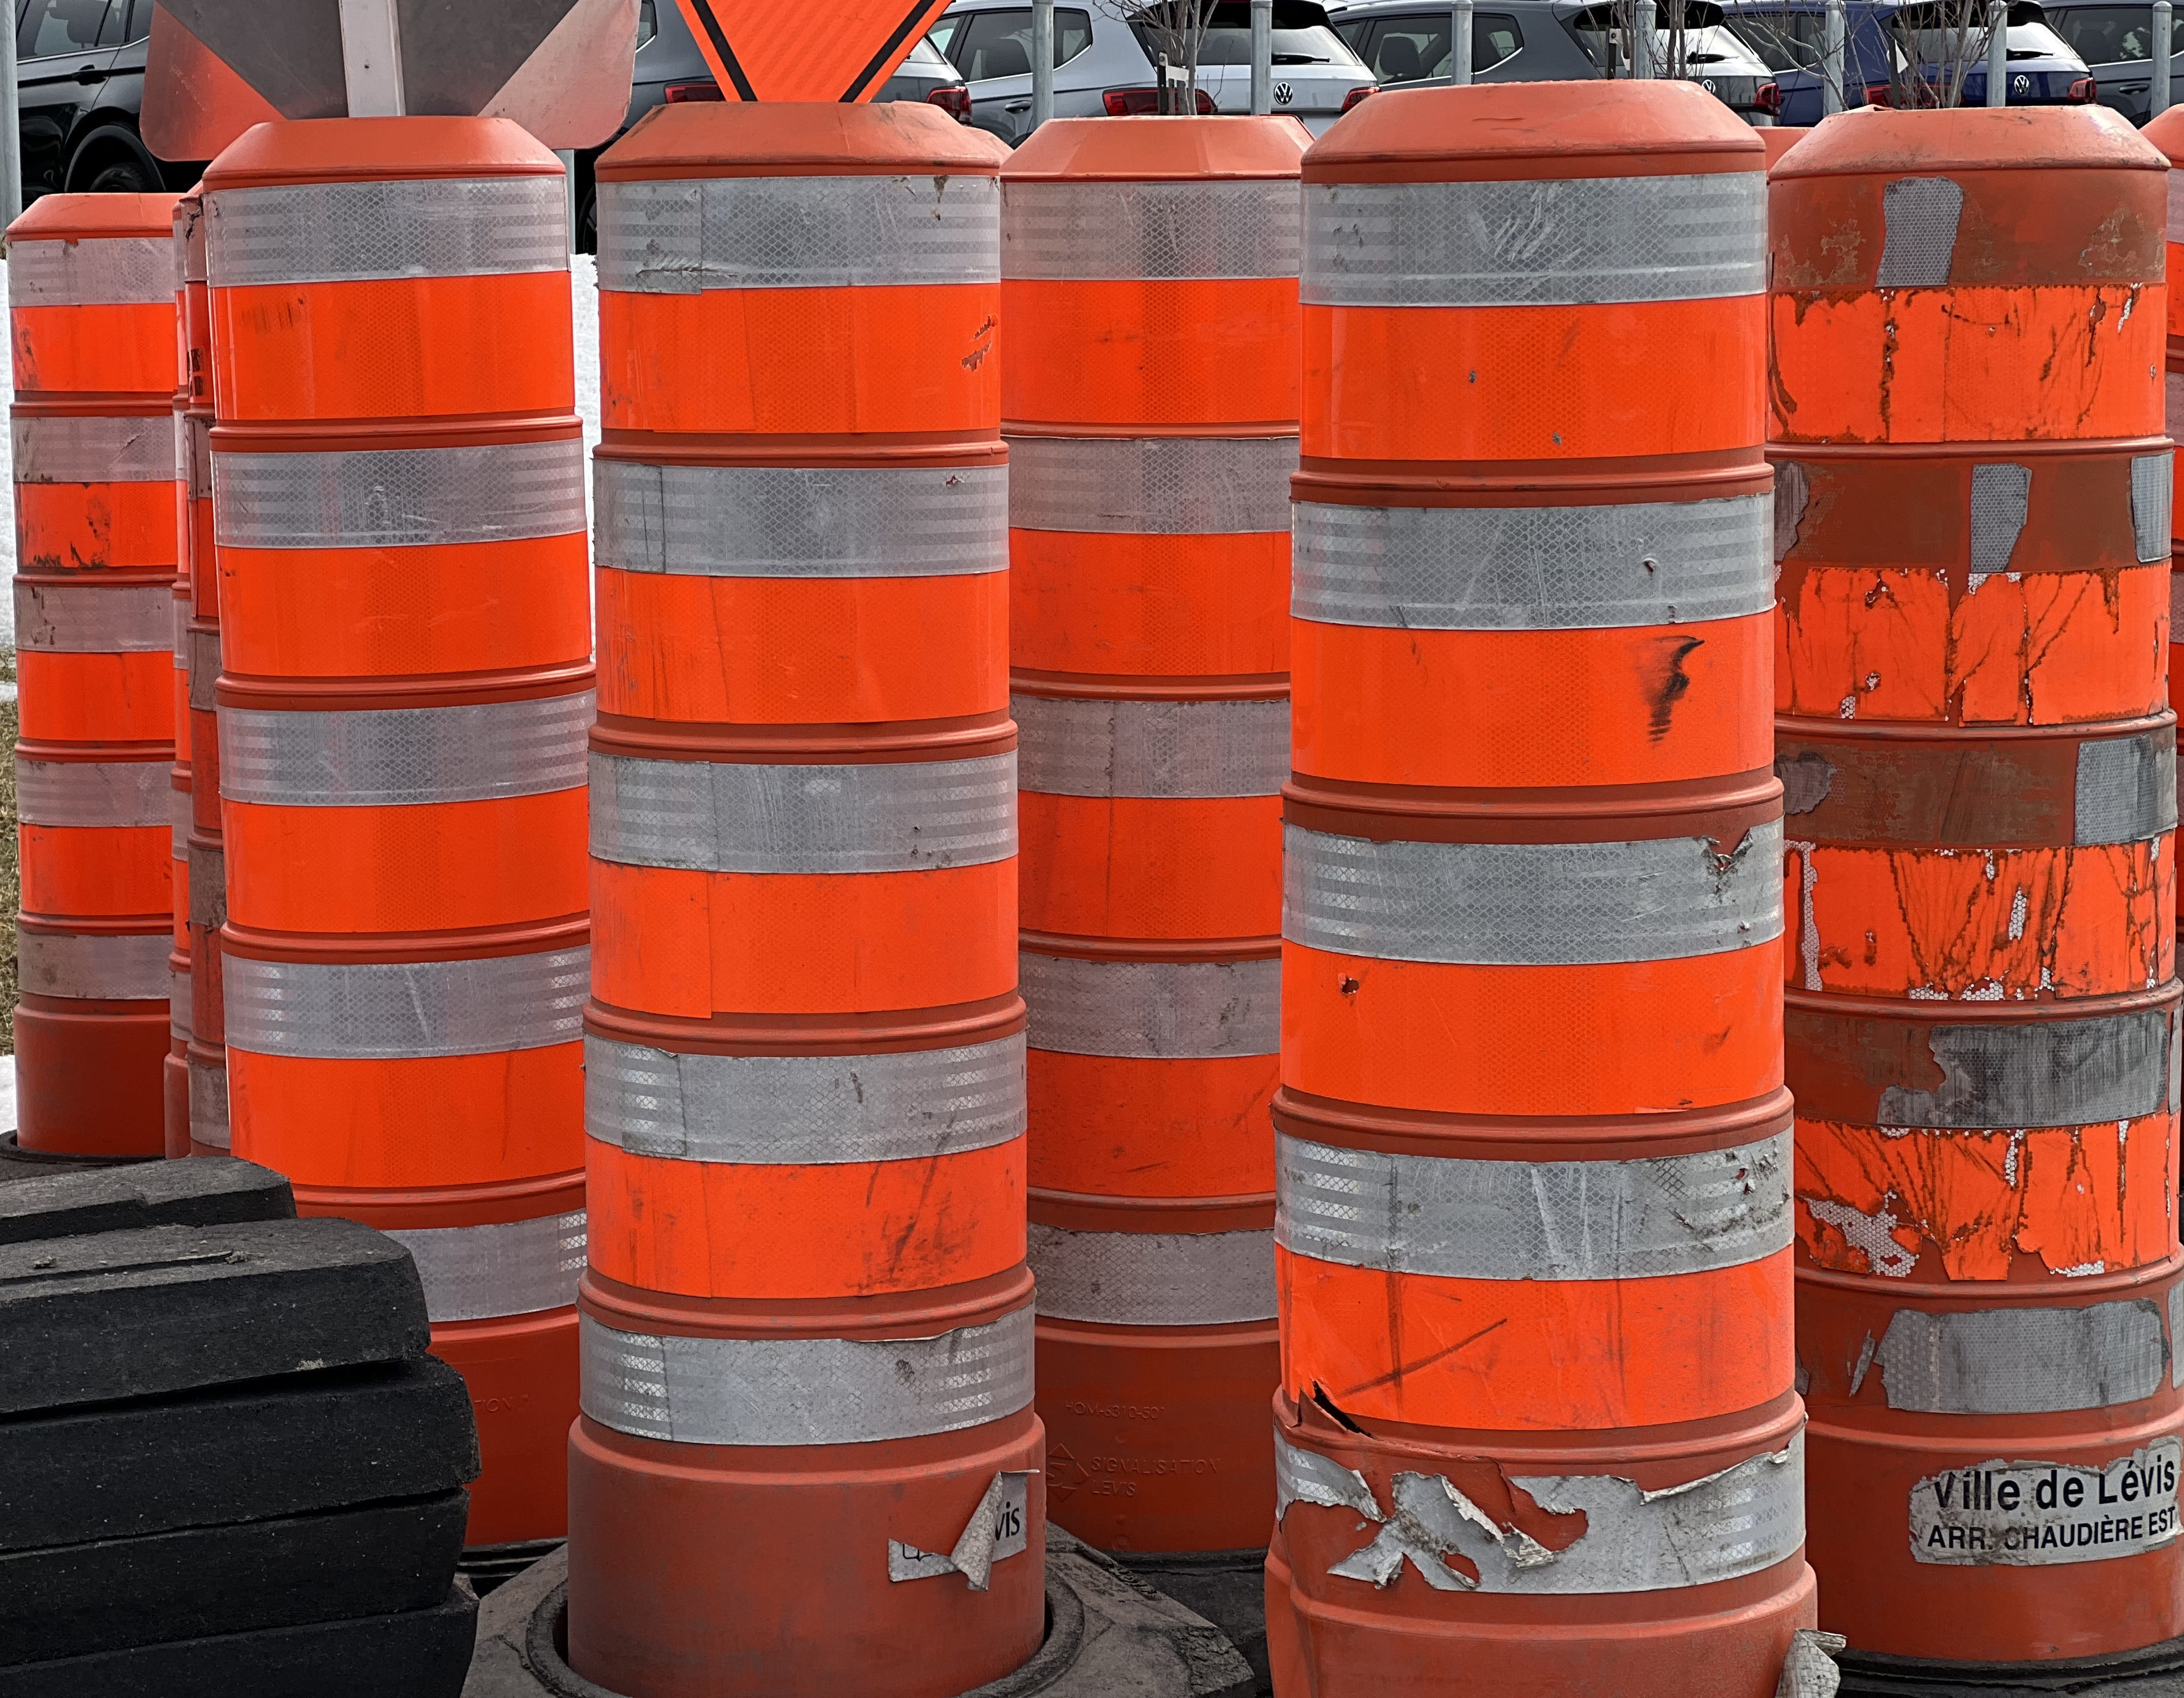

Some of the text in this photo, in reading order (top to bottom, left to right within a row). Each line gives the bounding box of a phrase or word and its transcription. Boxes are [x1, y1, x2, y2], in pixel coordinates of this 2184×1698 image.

[1091, 1456, 1220, 1475] SIGNALISATION
[1933, 1454, 2175, 1511] Ville de Lévis
[995, 1501, 1021, 1541] vis
[1927, 1505, 2176, 1550] ARR. CHAUDIÈRE EST
